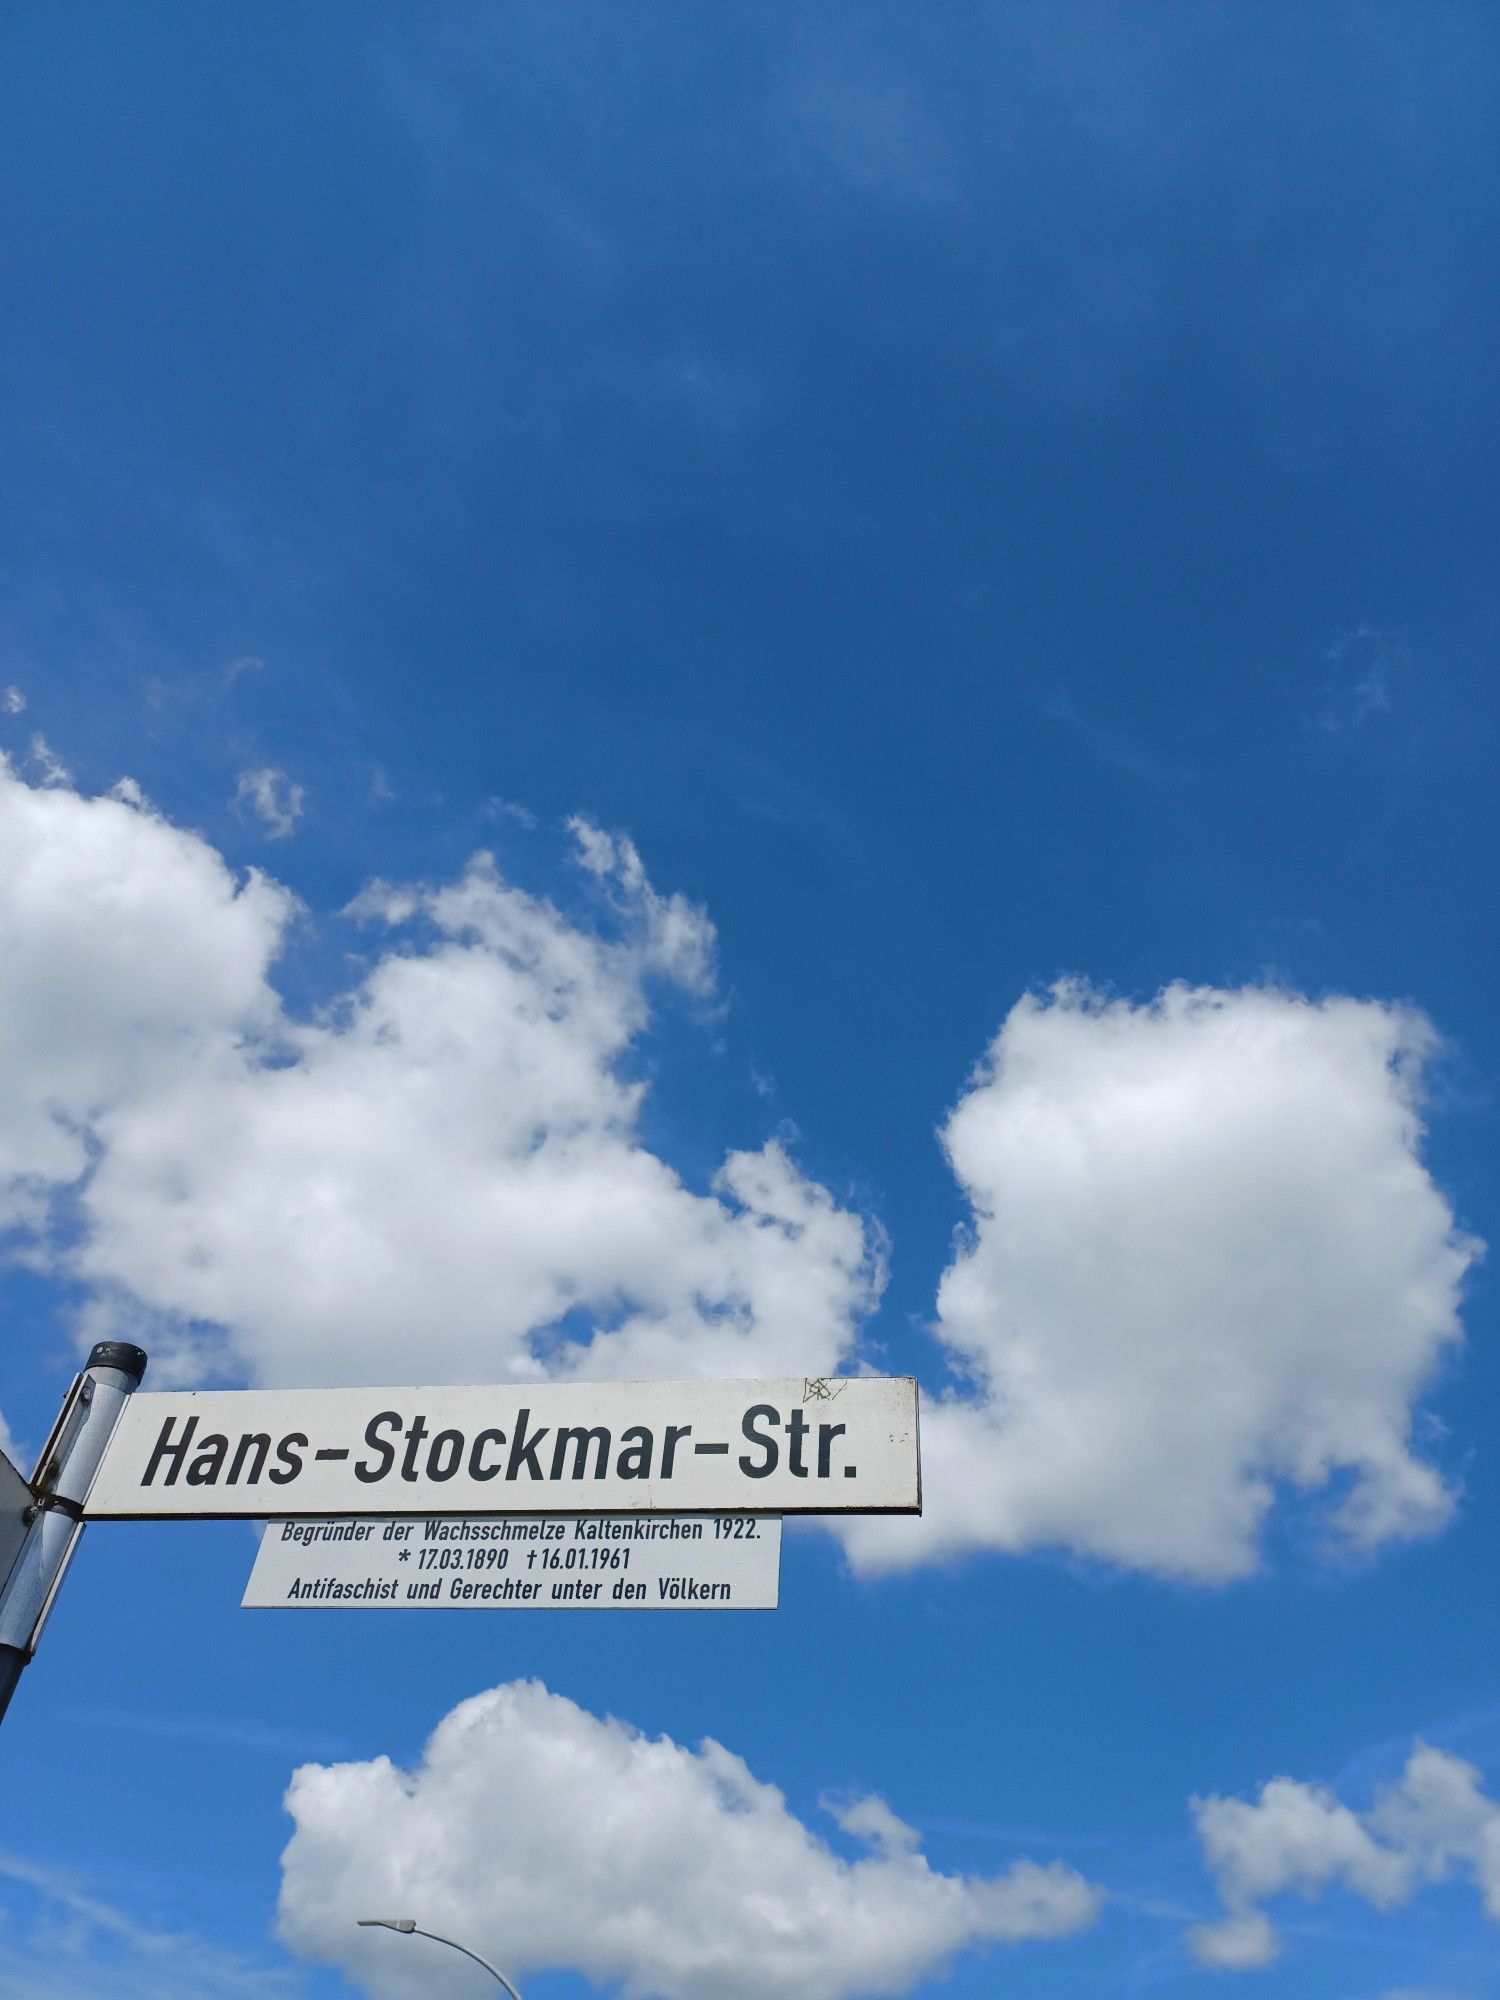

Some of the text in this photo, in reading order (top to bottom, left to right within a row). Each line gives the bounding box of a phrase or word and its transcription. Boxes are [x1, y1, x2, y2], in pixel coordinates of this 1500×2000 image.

[140, 1404, 857, 1486] Hans-Stockmar-Str.
[281, 1518, 761, 1546] Begründer der Wachsschmelze Kaltenkirchen 1922.
[287, 1578, 730, 1599] Antifaschist und Gerechter unter den Völkern
